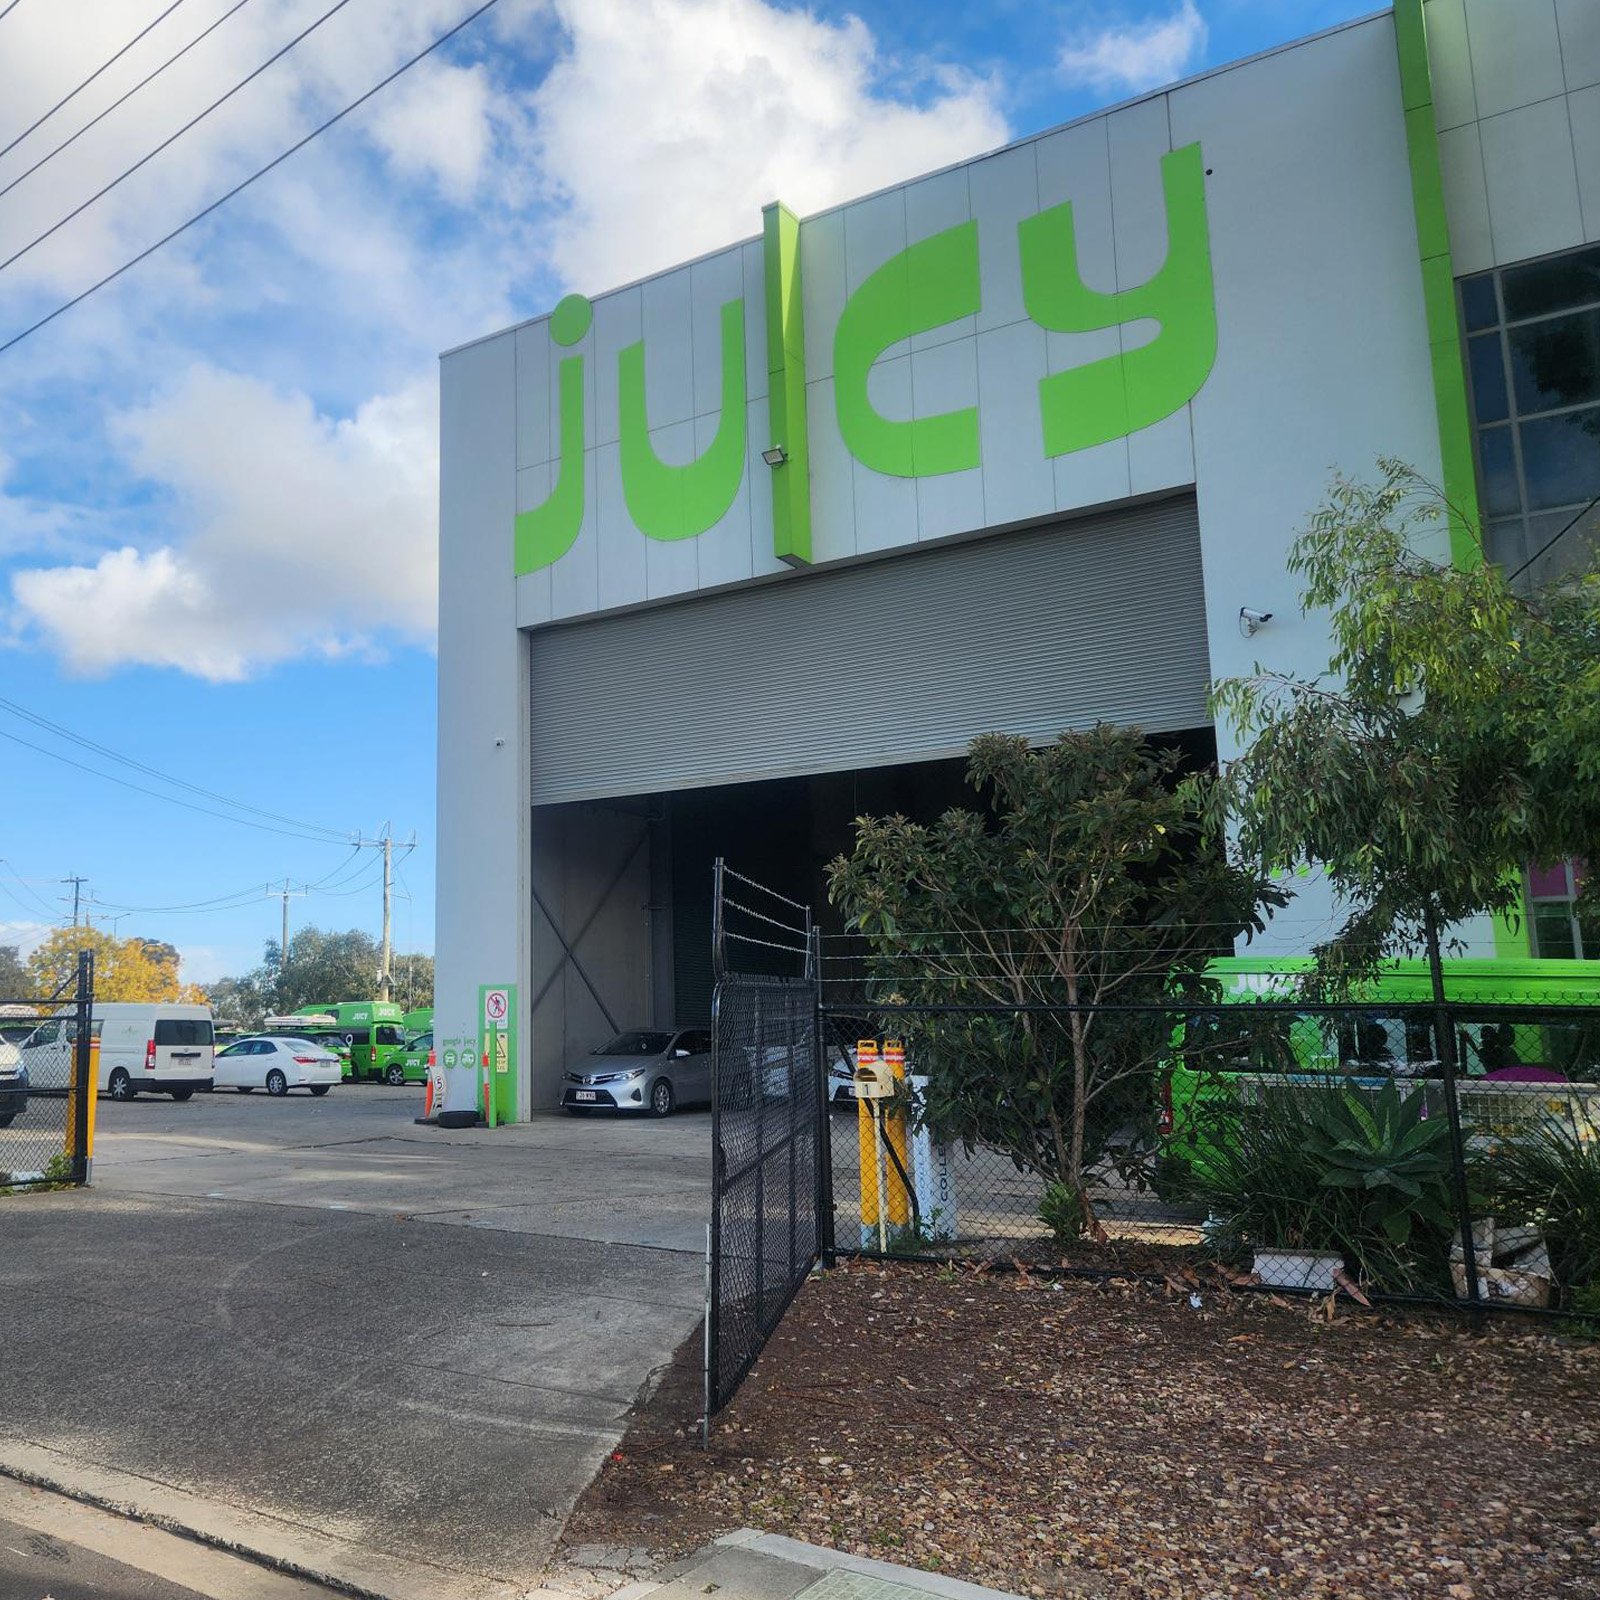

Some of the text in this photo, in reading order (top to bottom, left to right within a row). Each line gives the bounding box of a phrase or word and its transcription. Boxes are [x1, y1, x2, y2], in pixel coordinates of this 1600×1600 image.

[1230, 973, 1305, 996] JUC
[353, 1012, 368, 1020] JUCY
[379, 1007, 395, 1016] JUCY
[437, 1077, 443, 1090] 5
[939, 1142, 948, 1202] COLLE
